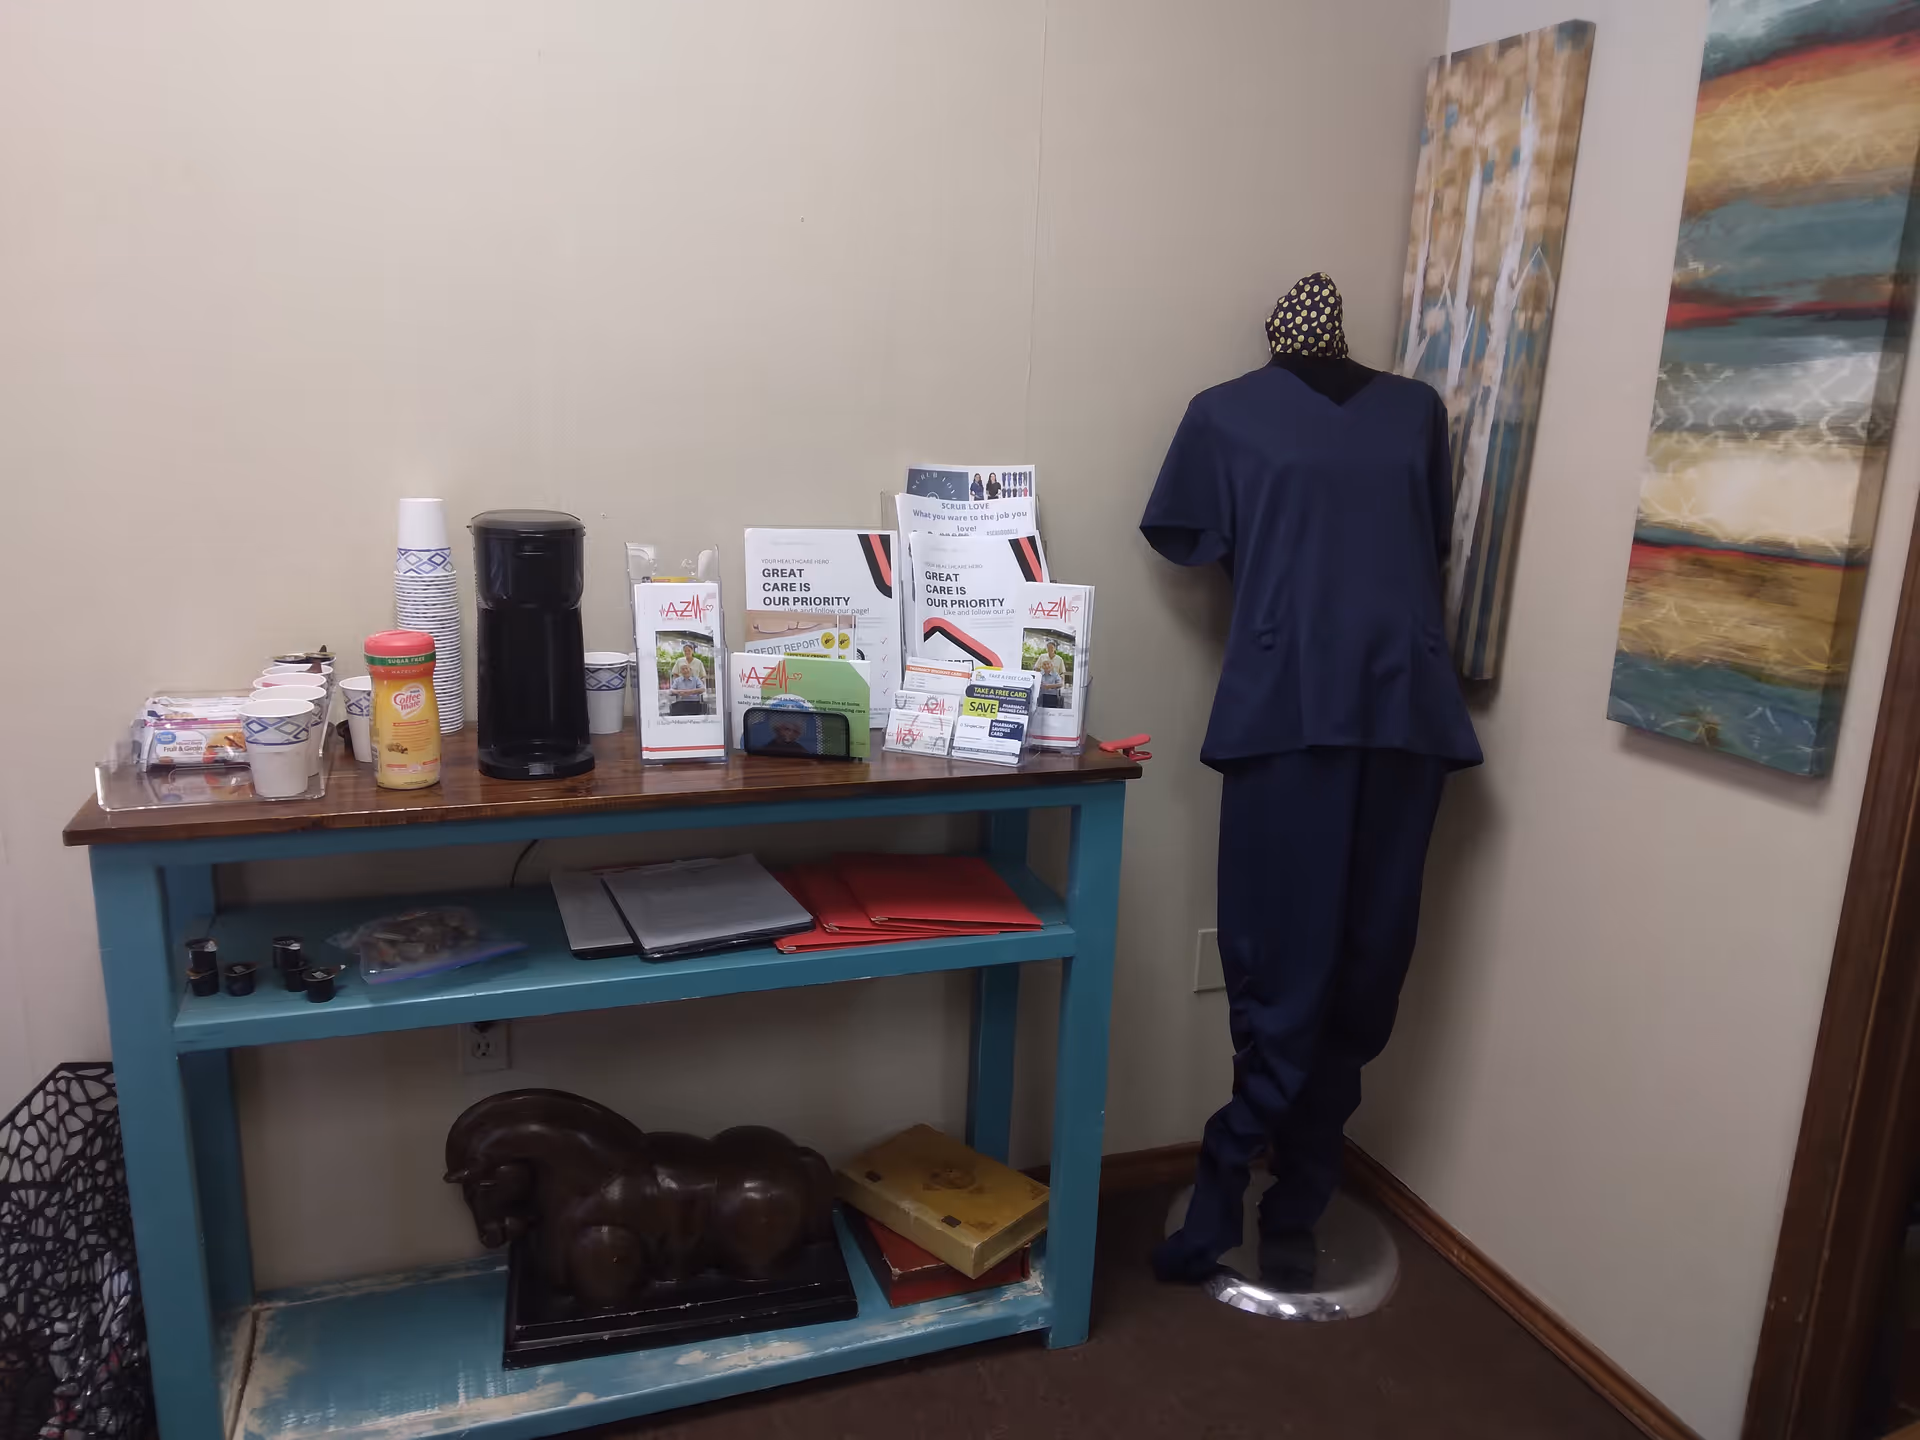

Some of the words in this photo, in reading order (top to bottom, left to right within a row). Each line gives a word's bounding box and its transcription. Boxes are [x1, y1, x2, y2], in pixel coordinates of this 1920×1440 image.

[942, 502, 966, 510] SCRUB
[968, 502, 990, 510] LOVE
[912, 509, 931, 519] What
[932, 512, 946, 522] you
[948, 513, 968, 521] ware
[970, 513, 978, 521] to
[980, 512, 994, 521] the
[1011, 511, 1028, 521] you
[957, 524, 977, 532] love!
[762, 568, 804, 578] GREAT
[925, 570, 960, 582] GREAT
[762, 582, 797, 592] CARE
[800, 582, 811, 592] IS
[926, 584, 953, 595] CARE
[956, 586, 966, 595] IS
[763, 596, 790, 606] OUR
[793, 596, 850, 606] PRIORITY
[926, 598, 948, 608] OUR
[950, 598, 1004, 608] PRIORITY
[851, 608, 870, 616] page!
[972, 608, 992, 616] follow
[784, 638, 820, 652] REPORT
[394, 692, 421, 706] Coffee
[1010, 690, 1027, 698] CARD
[401, 700, 420, 710] mate
[969, 701, 996, 714] SAVE
